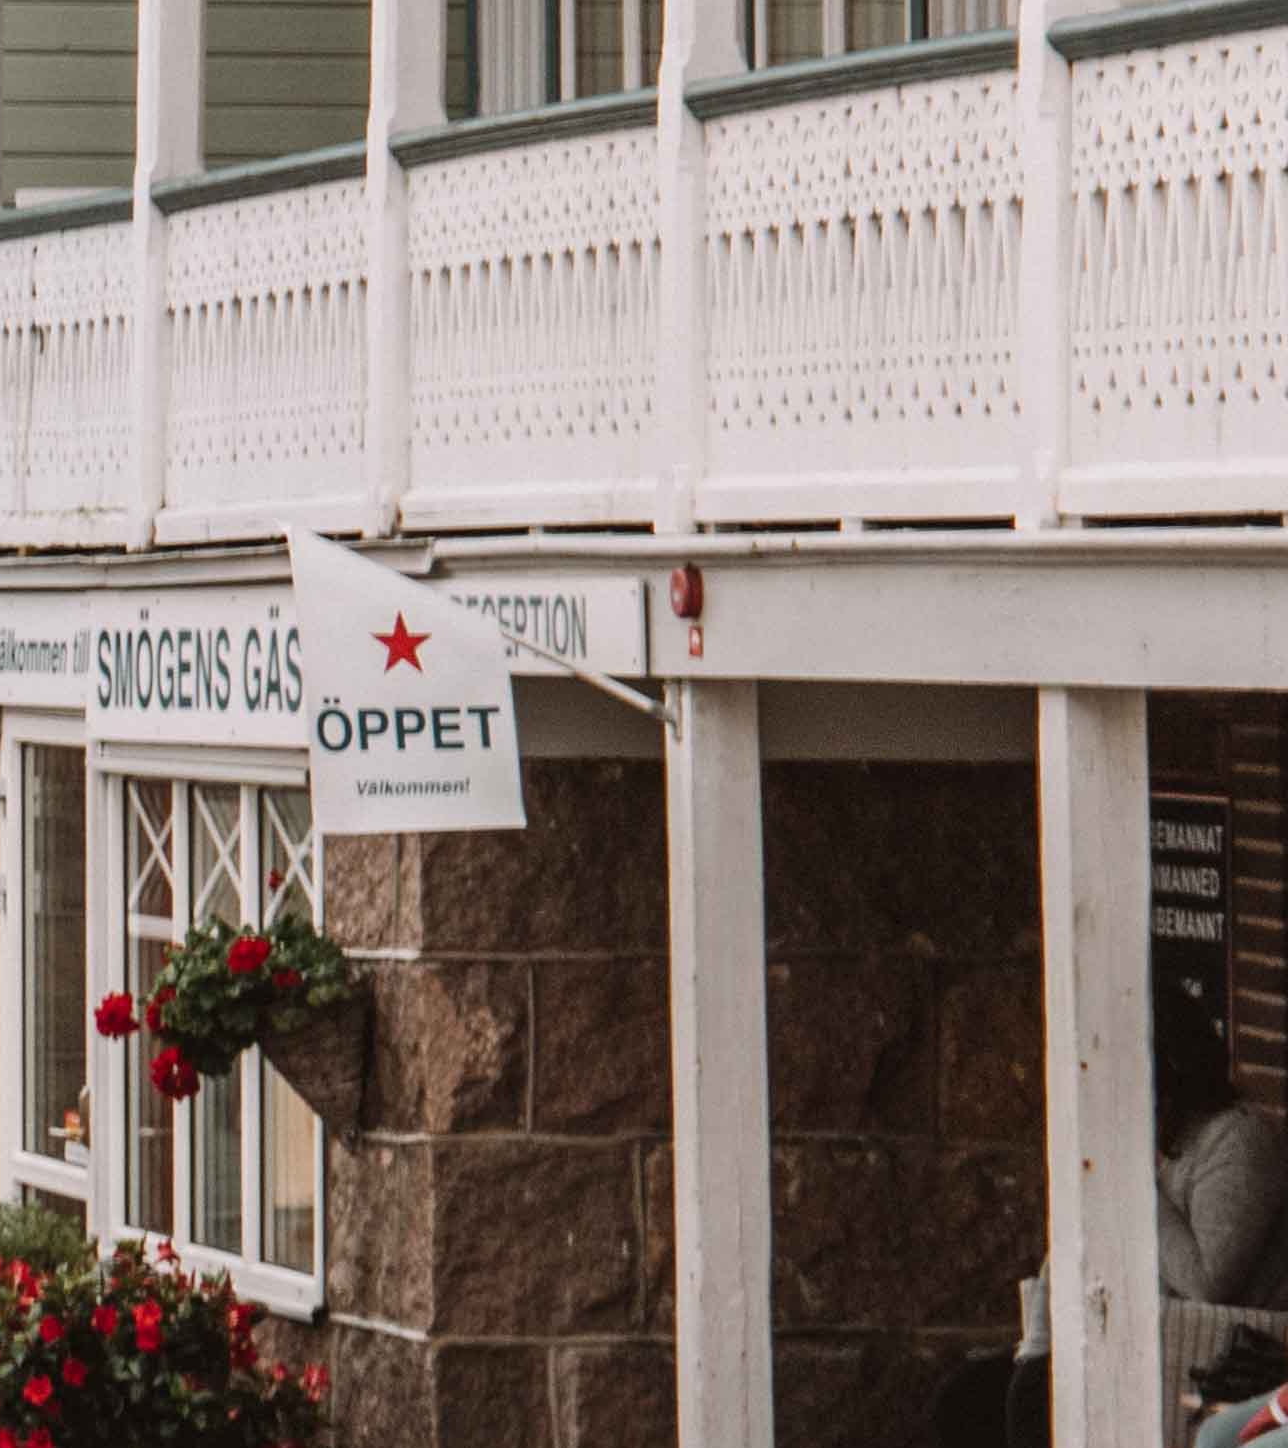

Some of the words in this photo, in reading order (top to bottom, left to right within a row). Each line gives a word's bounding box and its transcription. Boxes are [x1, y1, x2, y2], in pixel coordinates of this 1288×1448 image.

[451, 594, 588, 659] EPTION
[73, 628, 92, 675] till
[97, 608, 232, 711] SMÖGENS
[316, 697, 501, 752] ÖPPET
[356, 777, 472, 797] Välkommen!
